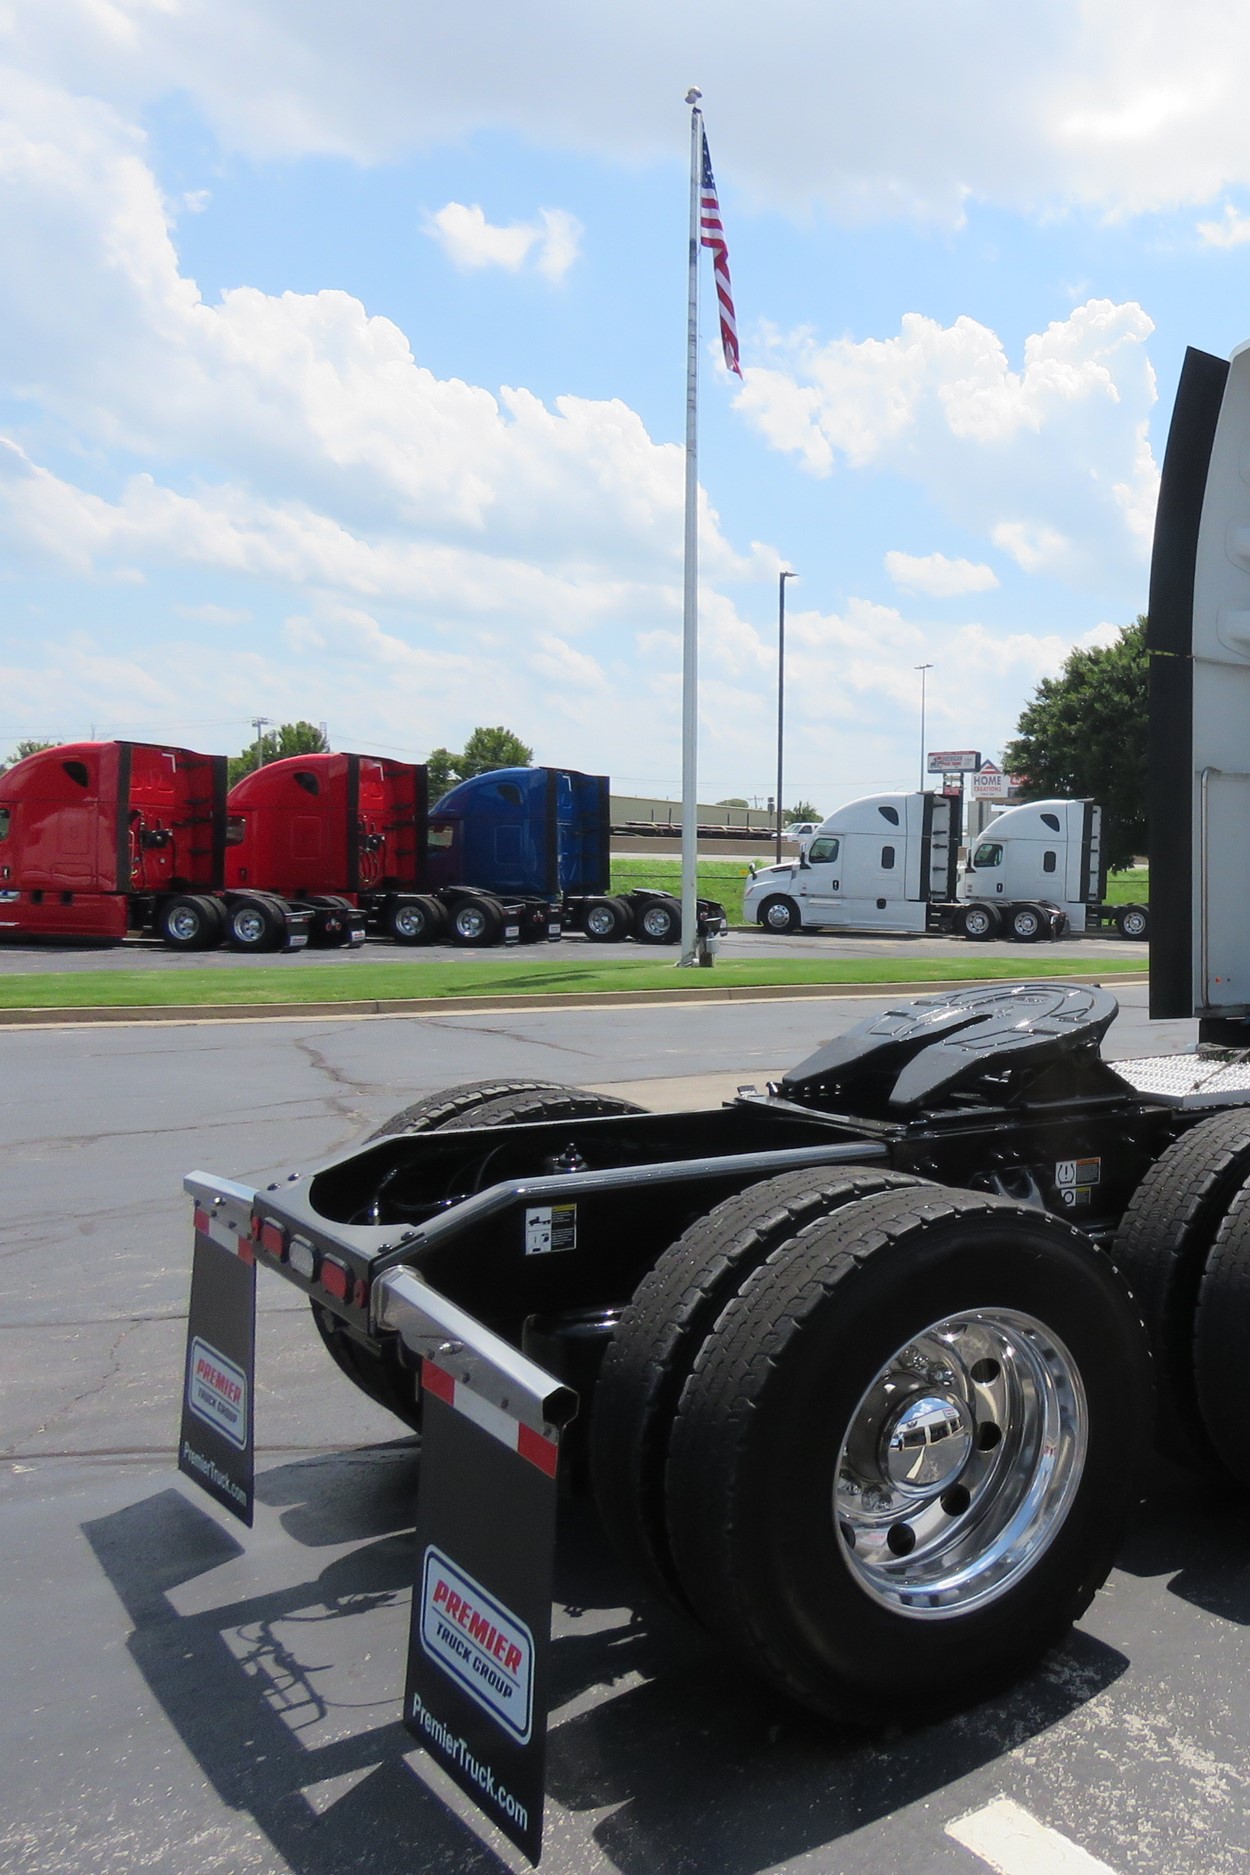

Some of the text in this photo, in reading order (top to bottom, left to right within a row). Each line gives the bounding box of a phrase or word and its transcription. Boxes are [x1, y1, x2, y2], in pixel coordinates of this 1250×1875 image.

[973, 775, 1001, 786] HOME
[196, 1359, 241, 1404] PREMIER
[197, 1386, 238, 1424] TRUCK GROUP
[183, 1440, 247, 1507] PremierTruck.com
[432, 1578, 523, 1675] PREMIER
[436, 1621, 513, 1699] TRUCK GROUP
[412, 1692, 529, 1832] PremierTruck.com
